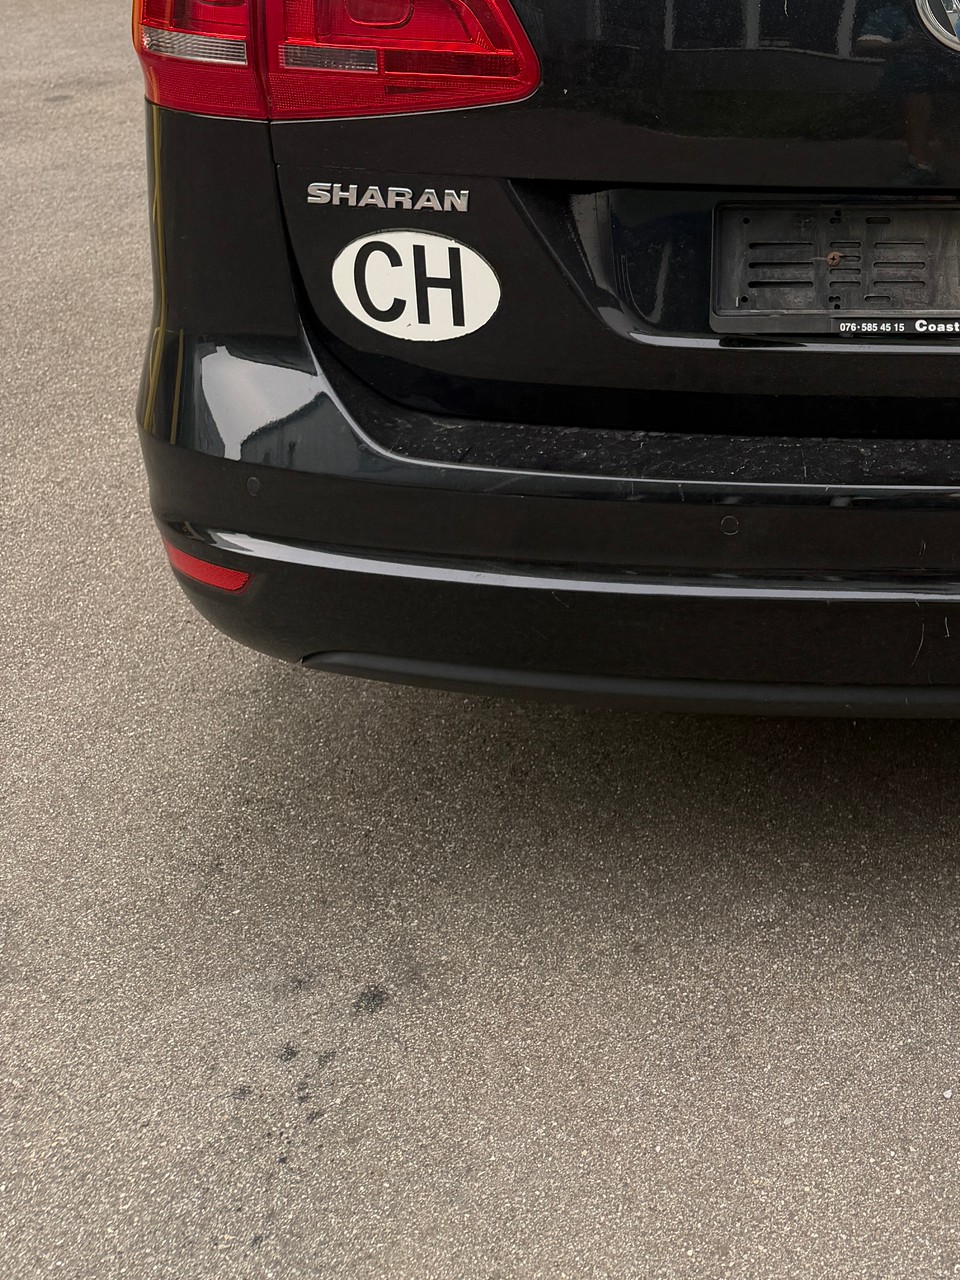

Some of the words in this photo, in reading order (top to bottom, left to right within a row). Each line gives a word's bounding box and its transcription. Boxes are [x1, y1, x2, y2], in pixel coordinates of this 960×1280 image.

[307, 182, 469, 212] SHARAN
[353, 240, 466, 327] CH
[879, 322, 892, 332] 45
[893, 322, 905, 332] 15
